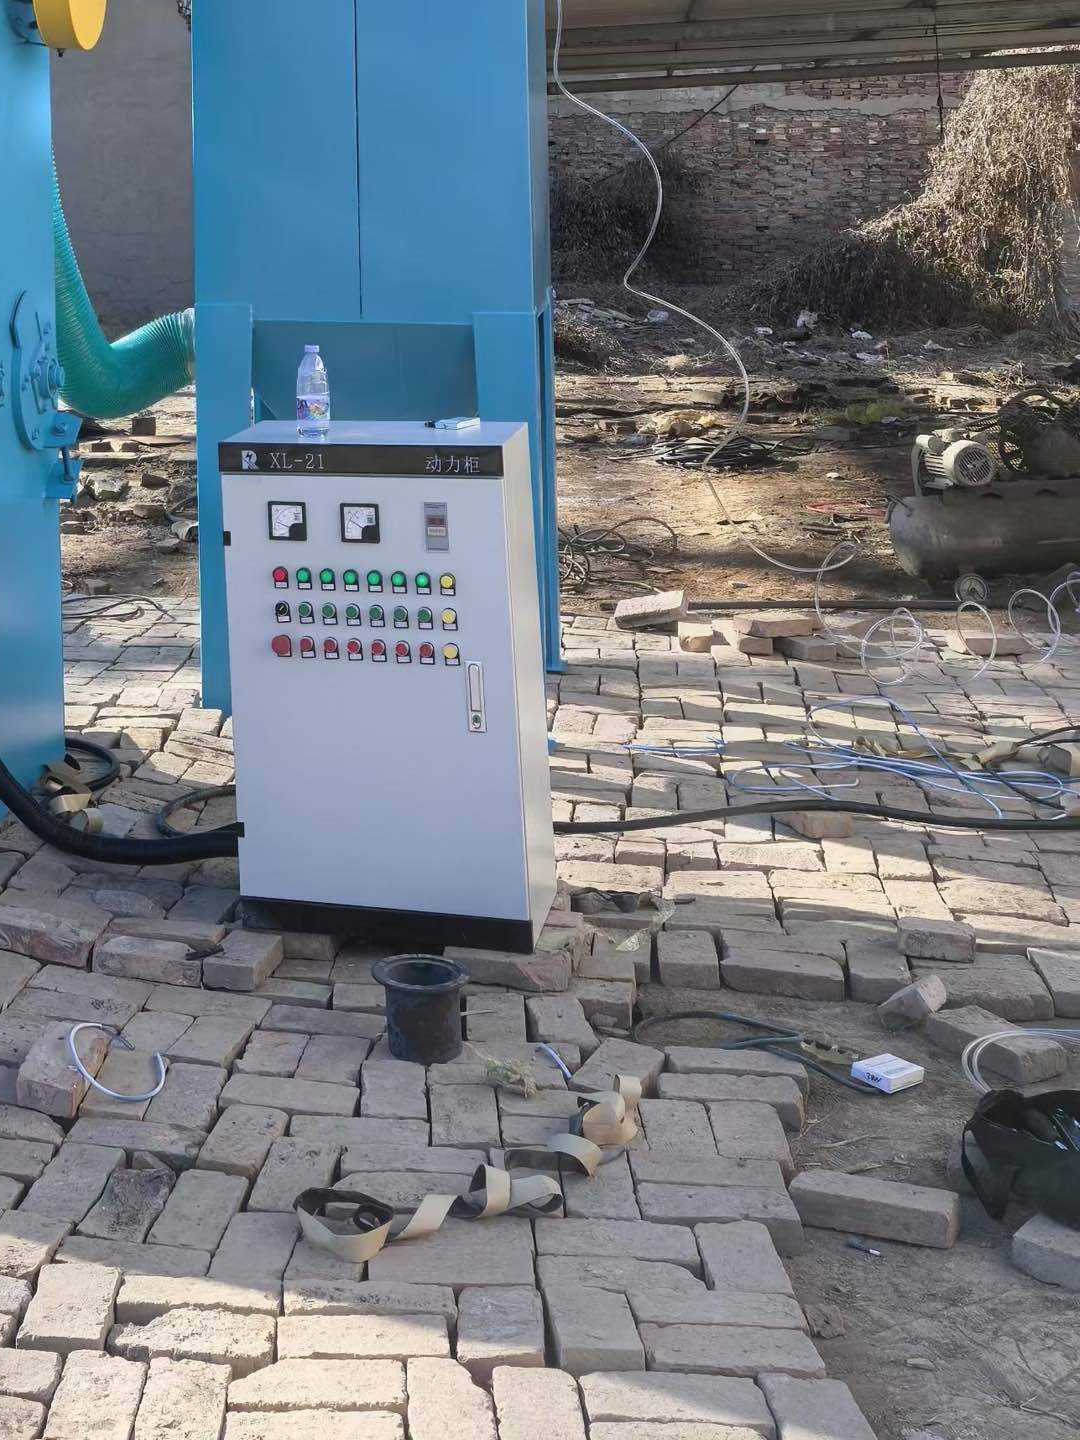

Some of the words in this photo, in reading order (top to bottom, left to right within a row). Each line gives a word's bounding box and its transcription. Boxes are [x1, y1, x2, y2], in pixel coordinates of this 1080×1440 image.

[269, 452, 325, 470] XL-21
[425, 455, 481, 473] 动力柜
